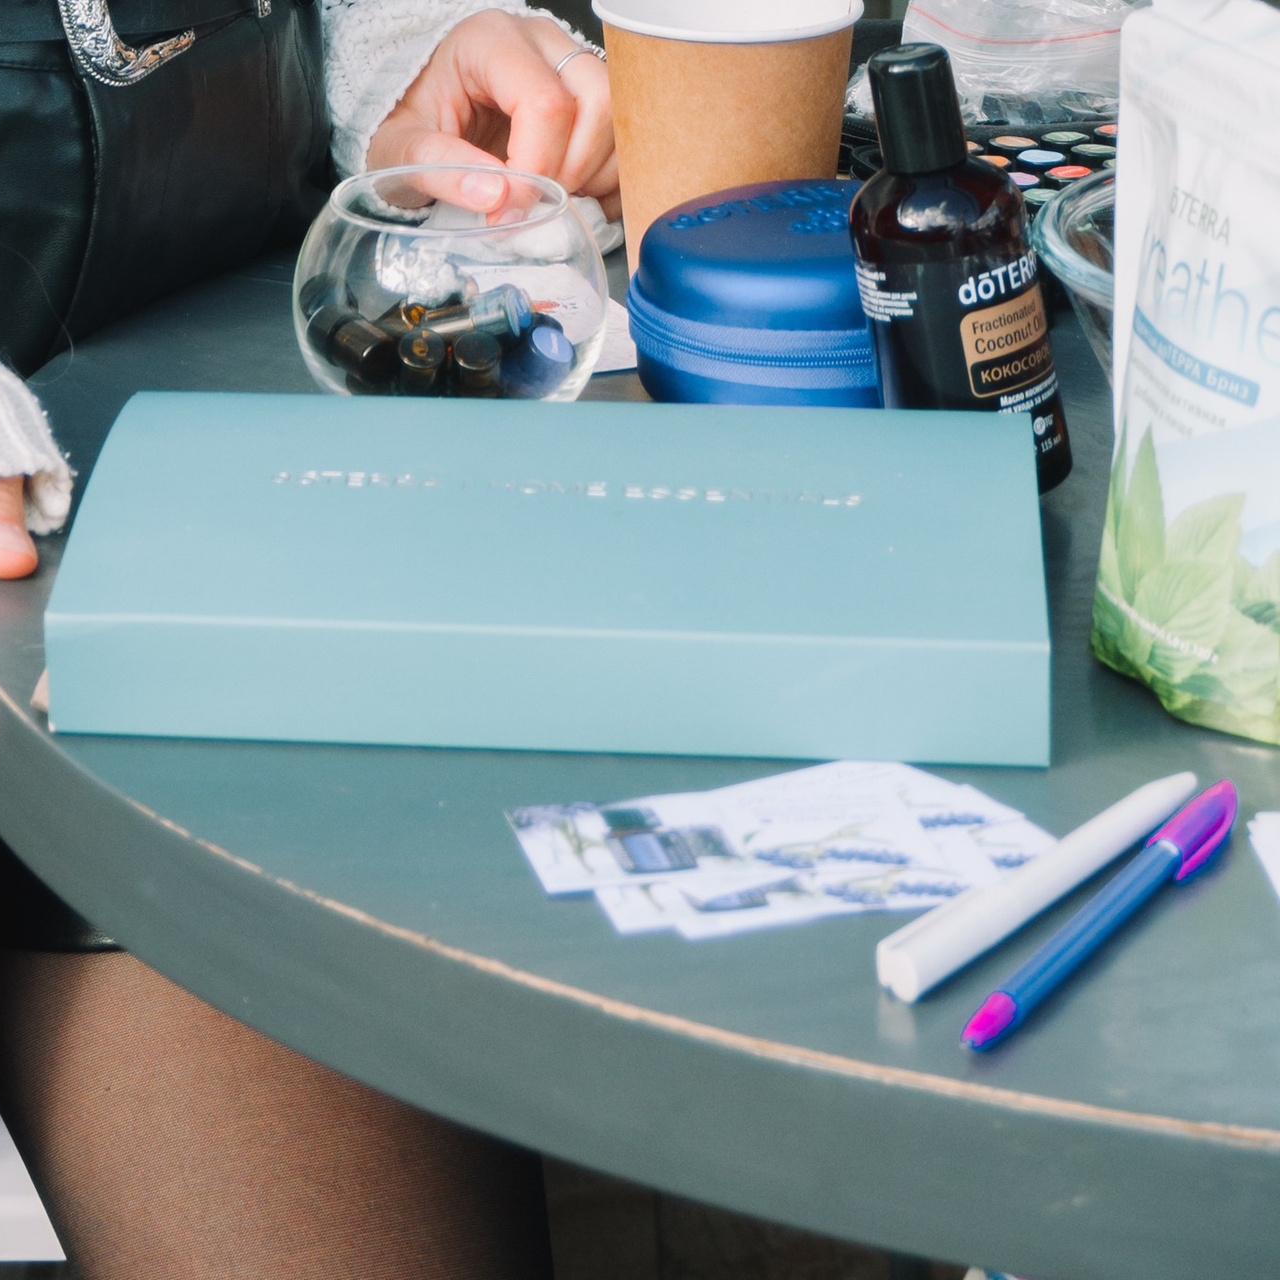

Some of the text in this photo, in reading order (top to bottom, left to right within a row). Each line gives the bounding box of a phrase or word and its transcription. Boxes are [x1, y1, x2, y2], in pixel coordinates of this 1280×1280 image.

[972, 300, 1037, 335] Fractionated
[974, 323, 1033, 355] Coconut
[1000, 392, 1025, 407] Масло
